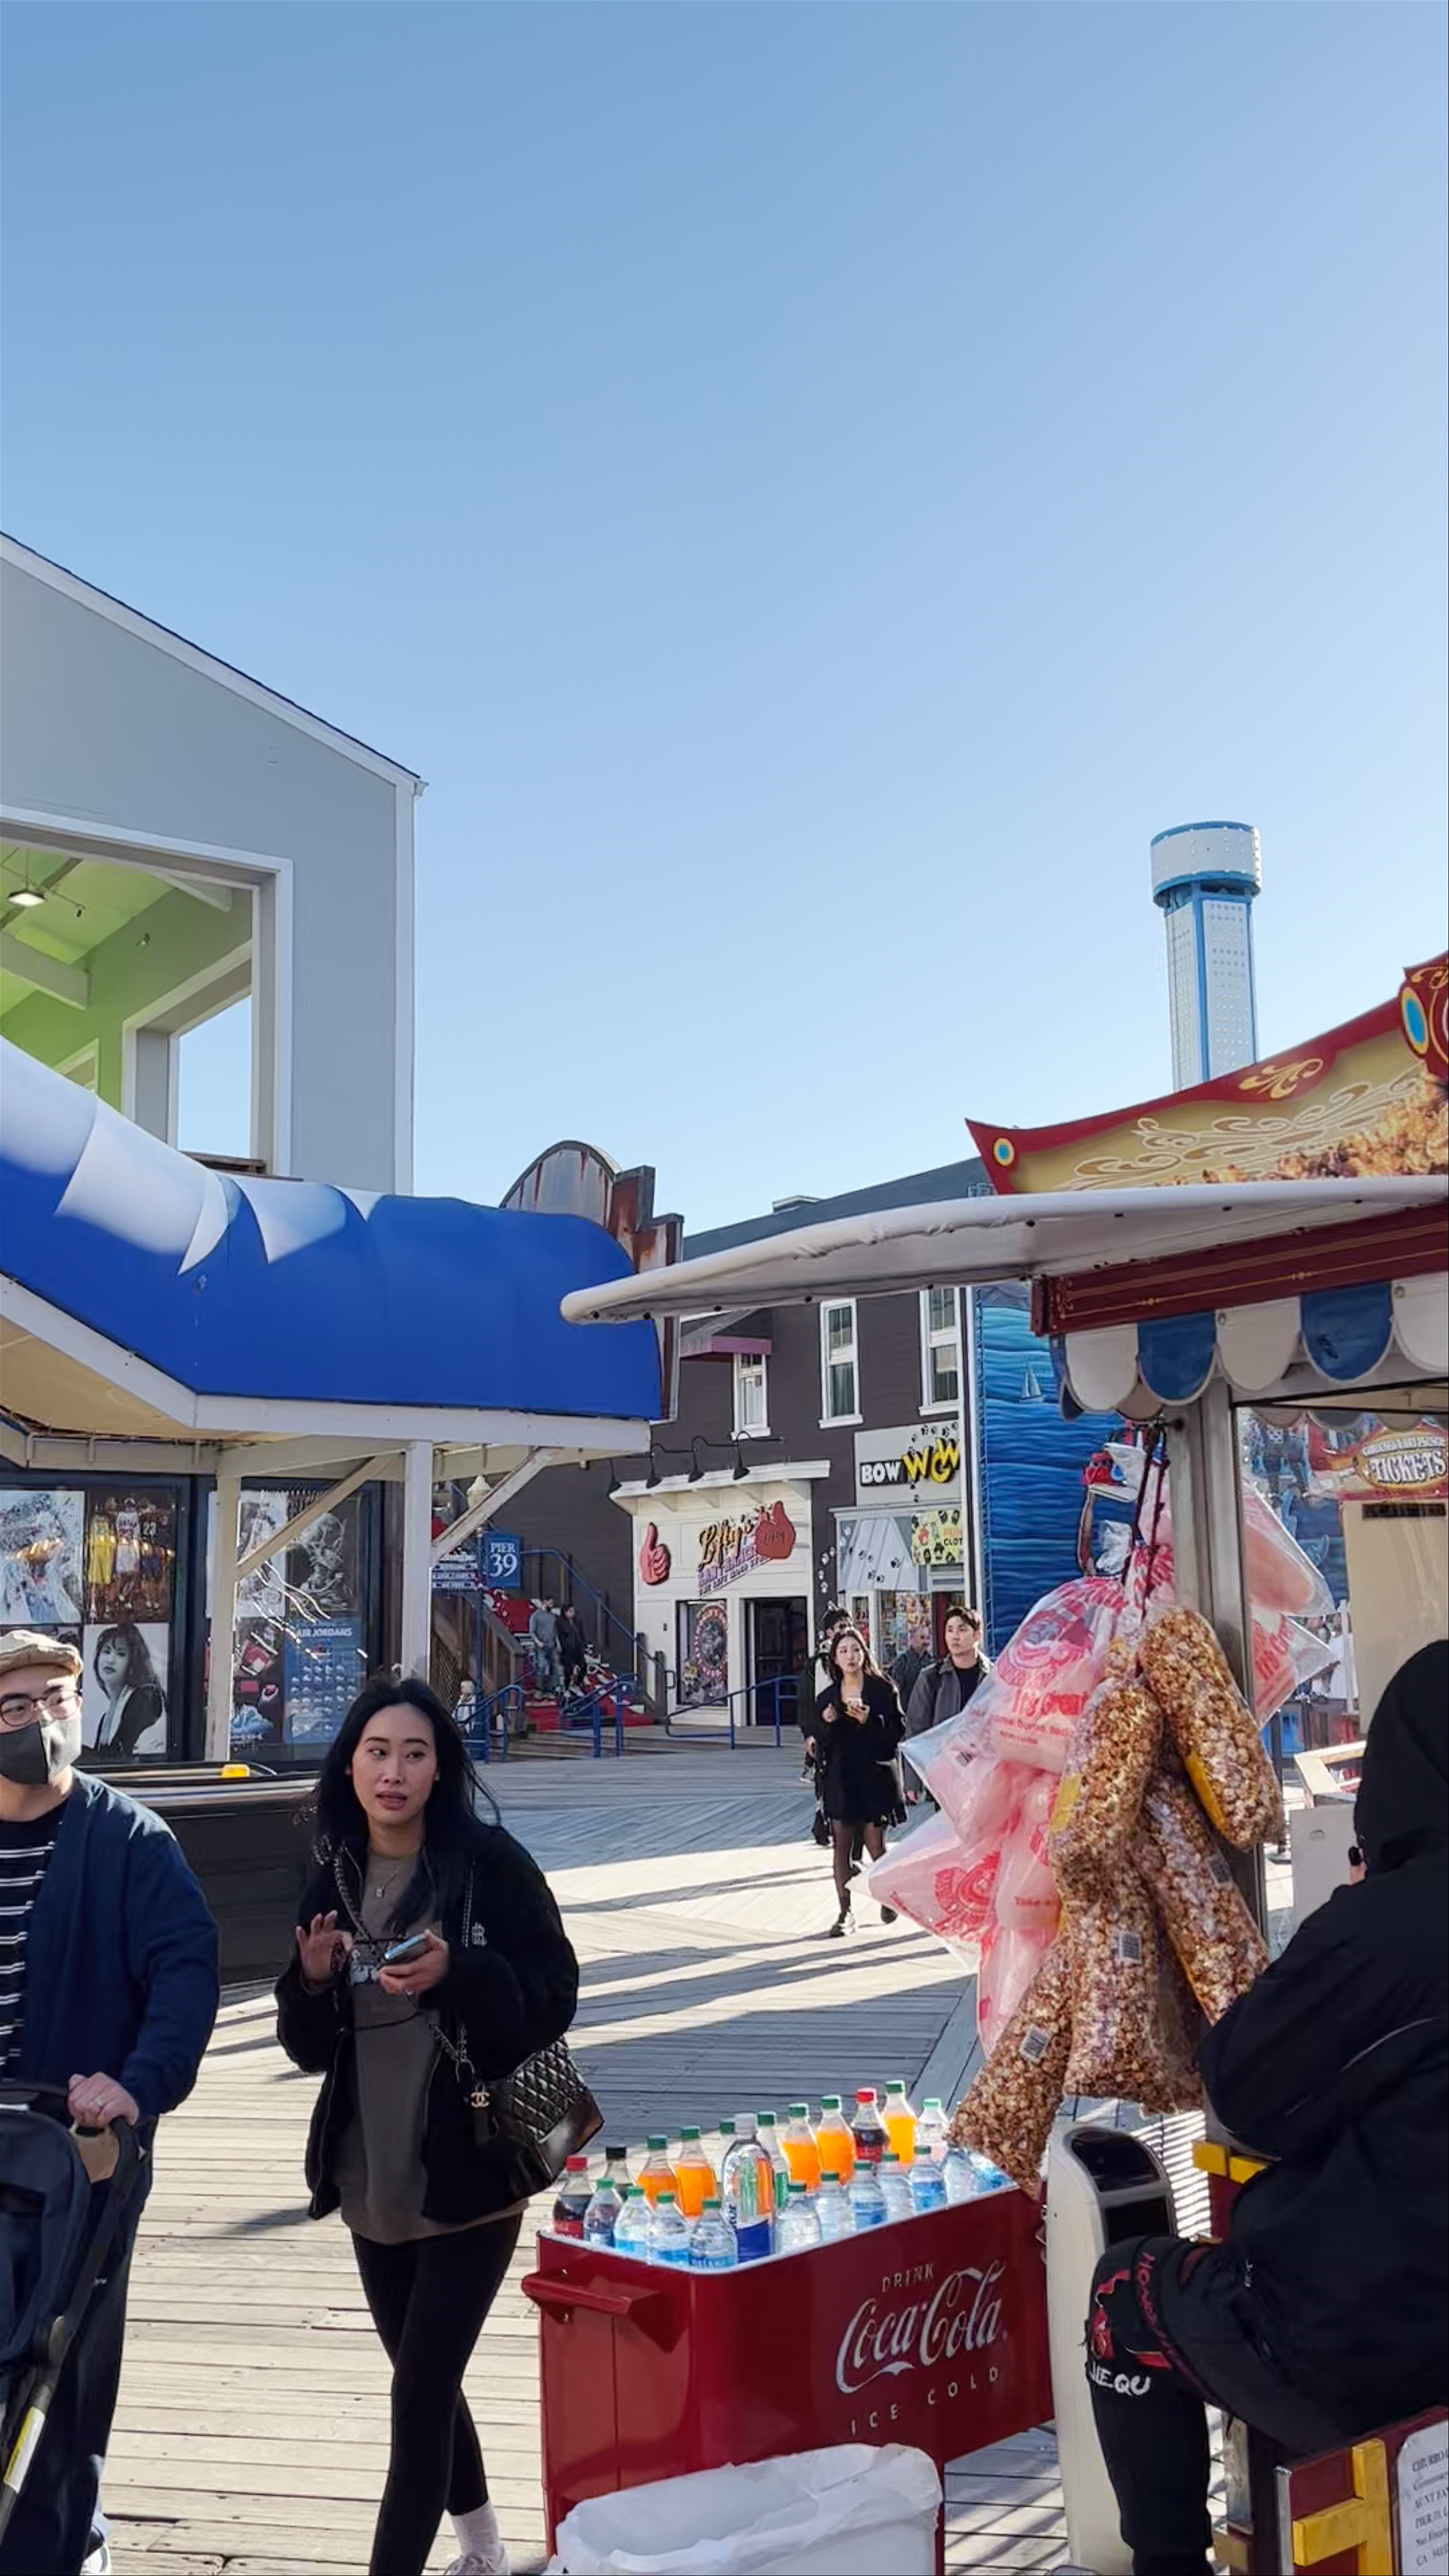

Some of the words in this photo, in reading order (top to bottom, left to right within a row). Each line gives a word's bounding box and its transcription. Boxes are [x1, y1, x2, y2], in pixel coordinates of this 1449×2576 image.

[861, 1461, 901, 1484] BOW
[901, 1438, 961, 1483] WOW
[1370, 1450, 1447, 1482] TICKETS
[491, 1542, 515, 1553] PIER
[490, 1553, 518, 1577] 39
[296, 1628, 311, 1637] AIR
[312, 1627, 353, 1637] JORDANS
[882, 2263, 934, 2293] DRINK
[836, 2260, 1005, 2393] Coca-Cola
[851, 2404, 901, 2436] ICE
[928, 2366, 998, 2405] COLD
